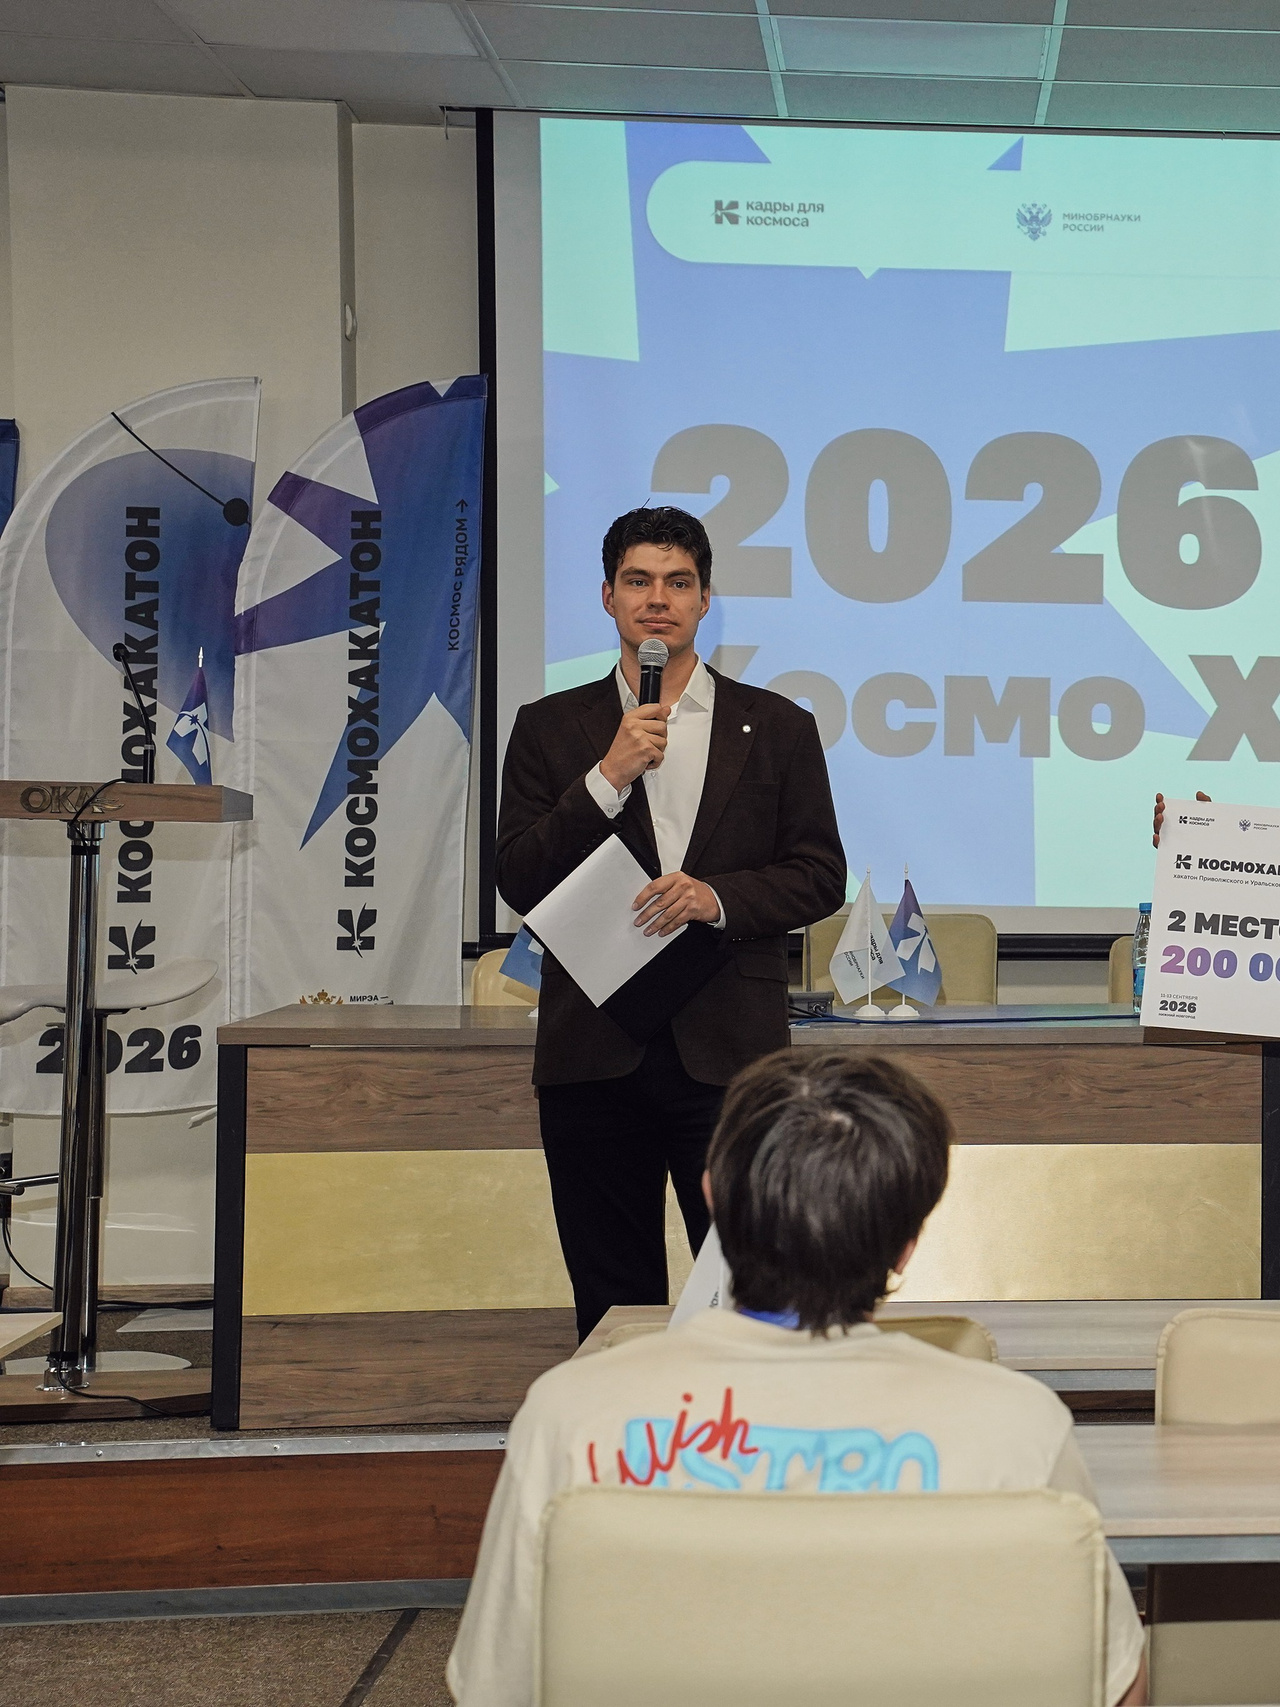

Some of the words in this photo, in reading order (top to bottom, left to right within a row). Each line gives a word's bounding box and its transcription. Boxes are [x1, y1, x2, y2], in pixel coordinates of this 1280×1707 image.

[746, 201, 794, 214] кадры
[797, 202, 825, 214] для
[746, 215, 809, 227] космоса
[1062, 213, 1141, 222] МИНОБРНАУКИ
[1062, 223, 1104, 232] РОССИИ
[650, 423, 1262, 610] 2026
[447, 581, 463, 651] КОСМОС
[455, 518, 469, 578] РЯДОМ
[344, 510, 382, 888] КОСМОХАКАТОН
[702, 644, 1145, 761] осмо
[1199, 875, 1244, 885] Приволжского
[1167, 910, 1187, 932] 2
[1160, 945, 1238, 979] 200
[350, 995, 379, 1003] МИРЭА
[1159, 1000, 1197, 1013] 2026
